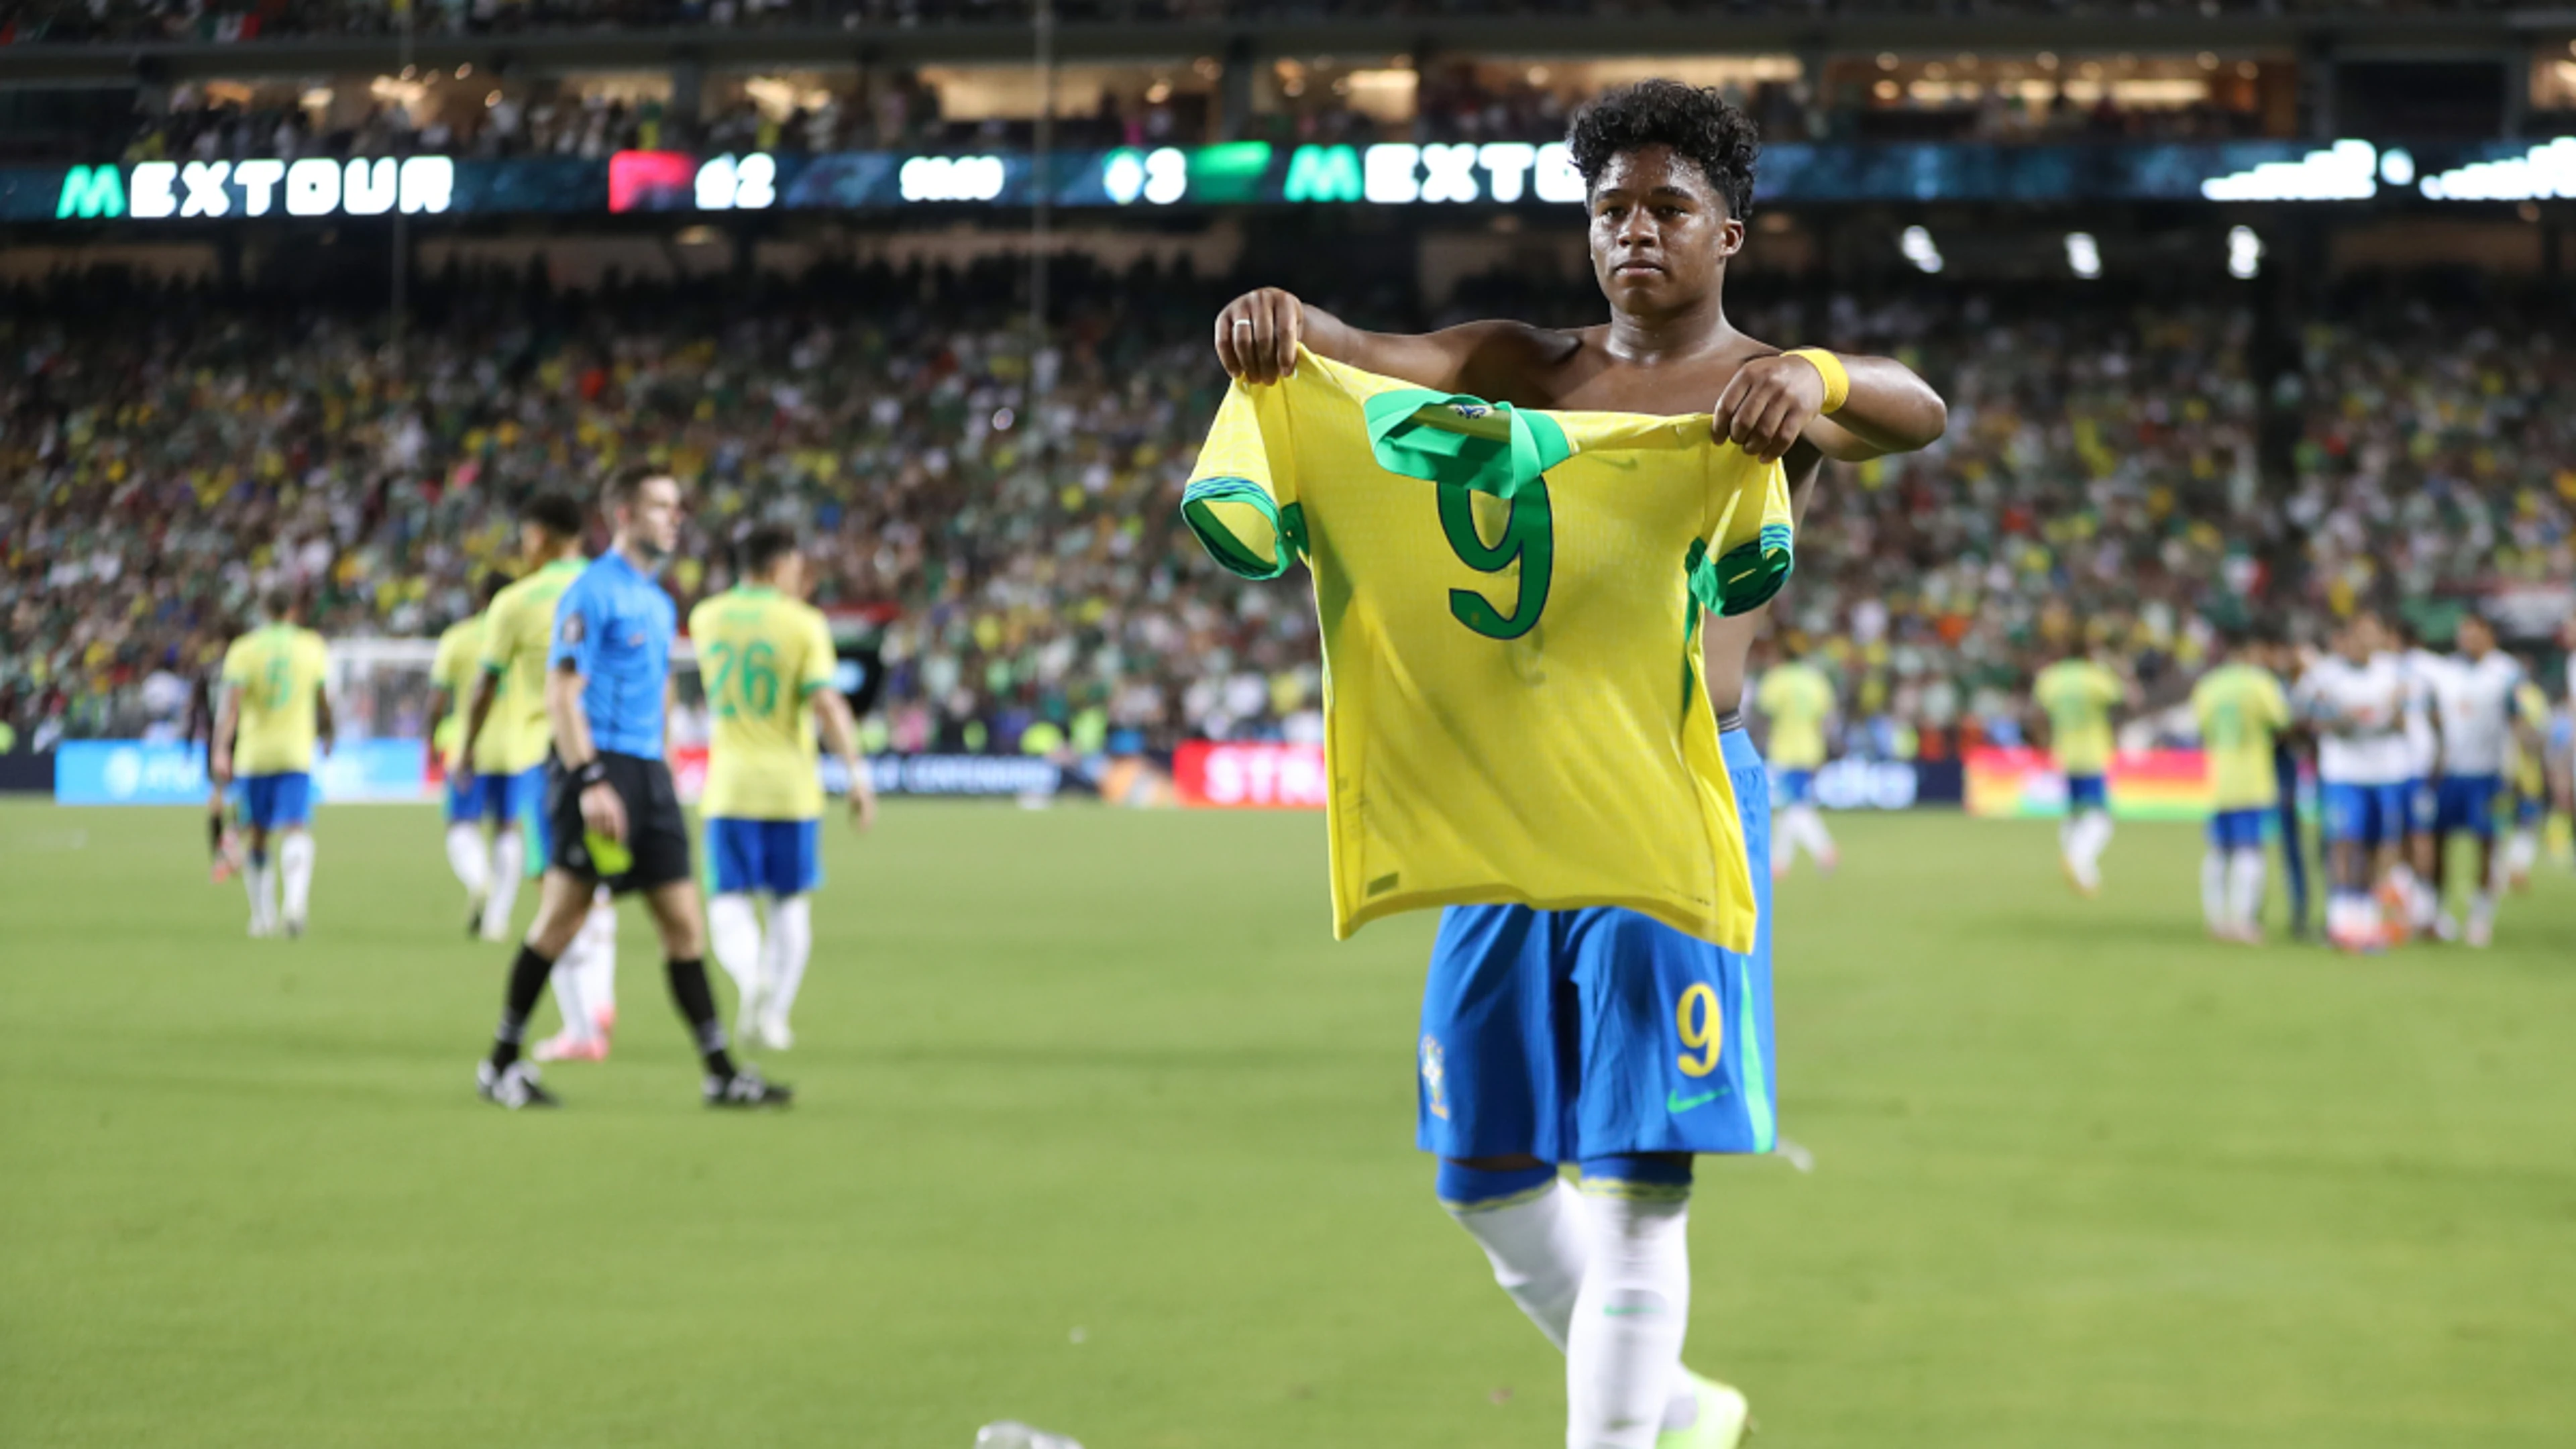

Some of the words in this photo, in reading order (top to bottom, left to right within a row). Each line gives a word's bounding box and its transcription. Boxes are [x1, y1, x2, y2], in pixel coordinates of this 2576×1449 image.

[56, 156, 454, 218] MEXTOUR
[1436, 472, 1554, 641] 9
[708, 639, 780, 720] 26
[1677, 983, 1722, 1077] 9
